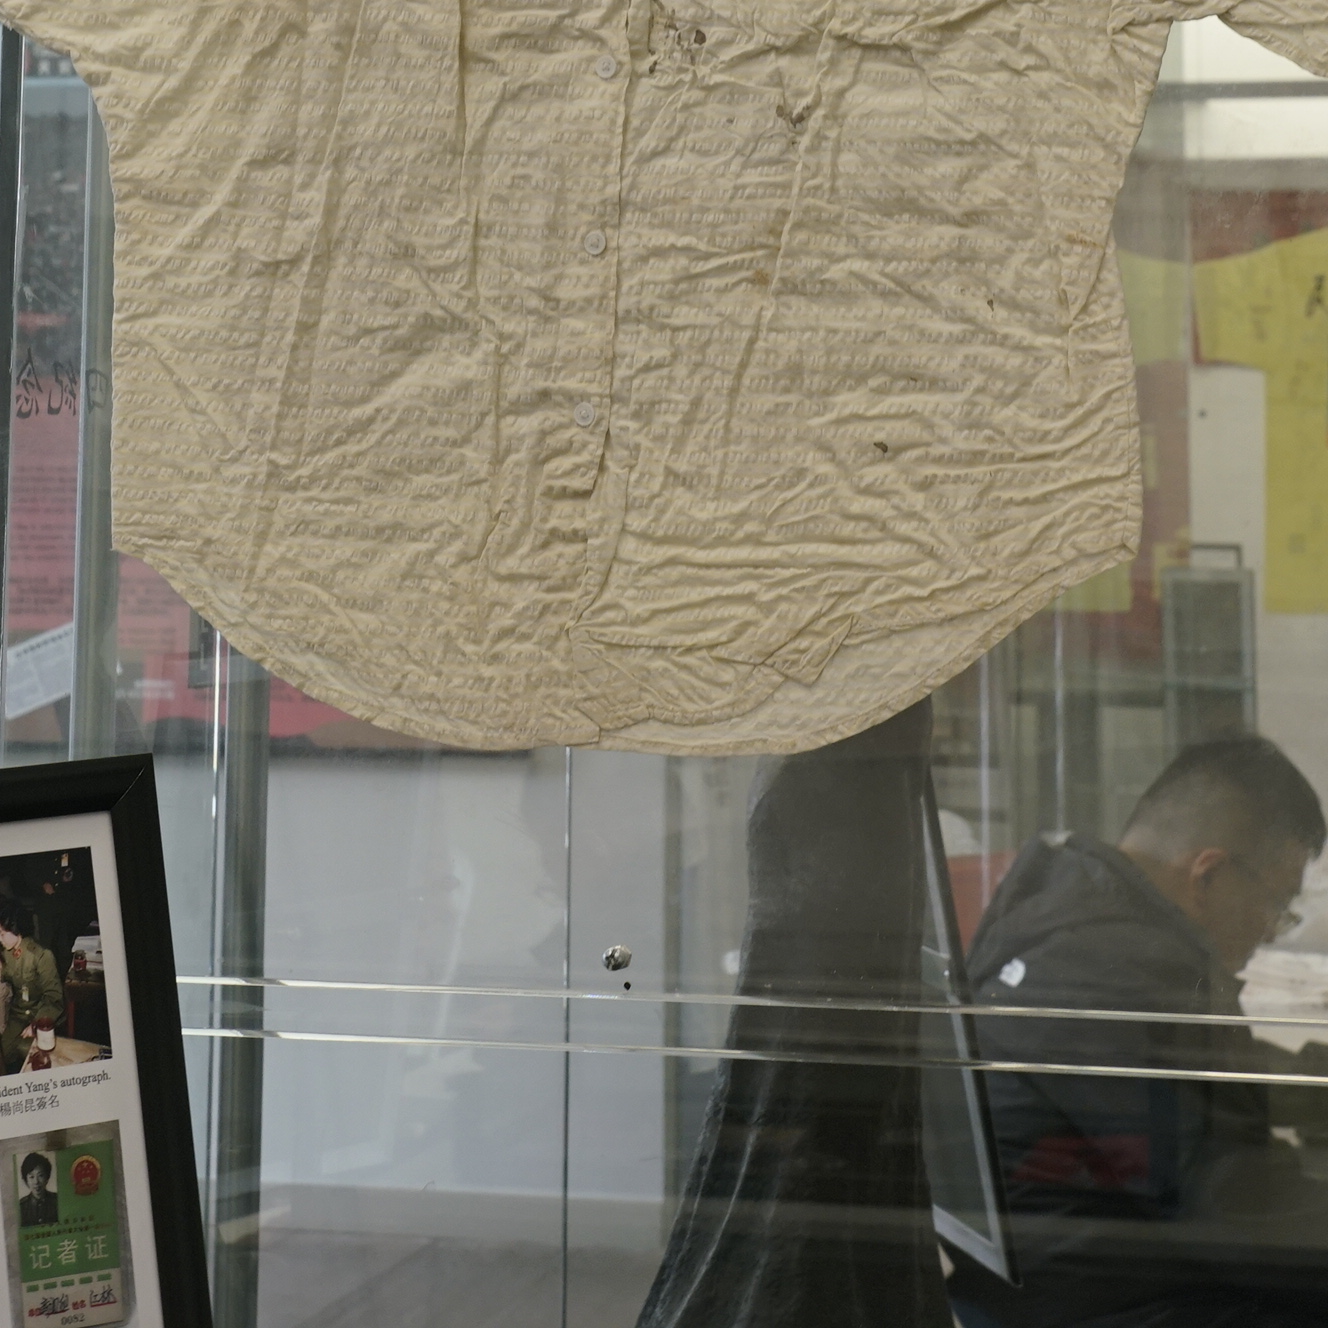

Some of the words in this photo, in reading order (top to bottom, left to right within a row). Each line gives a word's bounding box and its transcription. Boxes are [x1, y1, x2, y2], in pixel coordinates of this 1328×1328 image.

[25, 1079, 58, 1093] Yang’s
[60, 1070, 111, 1088] autograph.
[29, 1234, 109, 1270] 记者证
